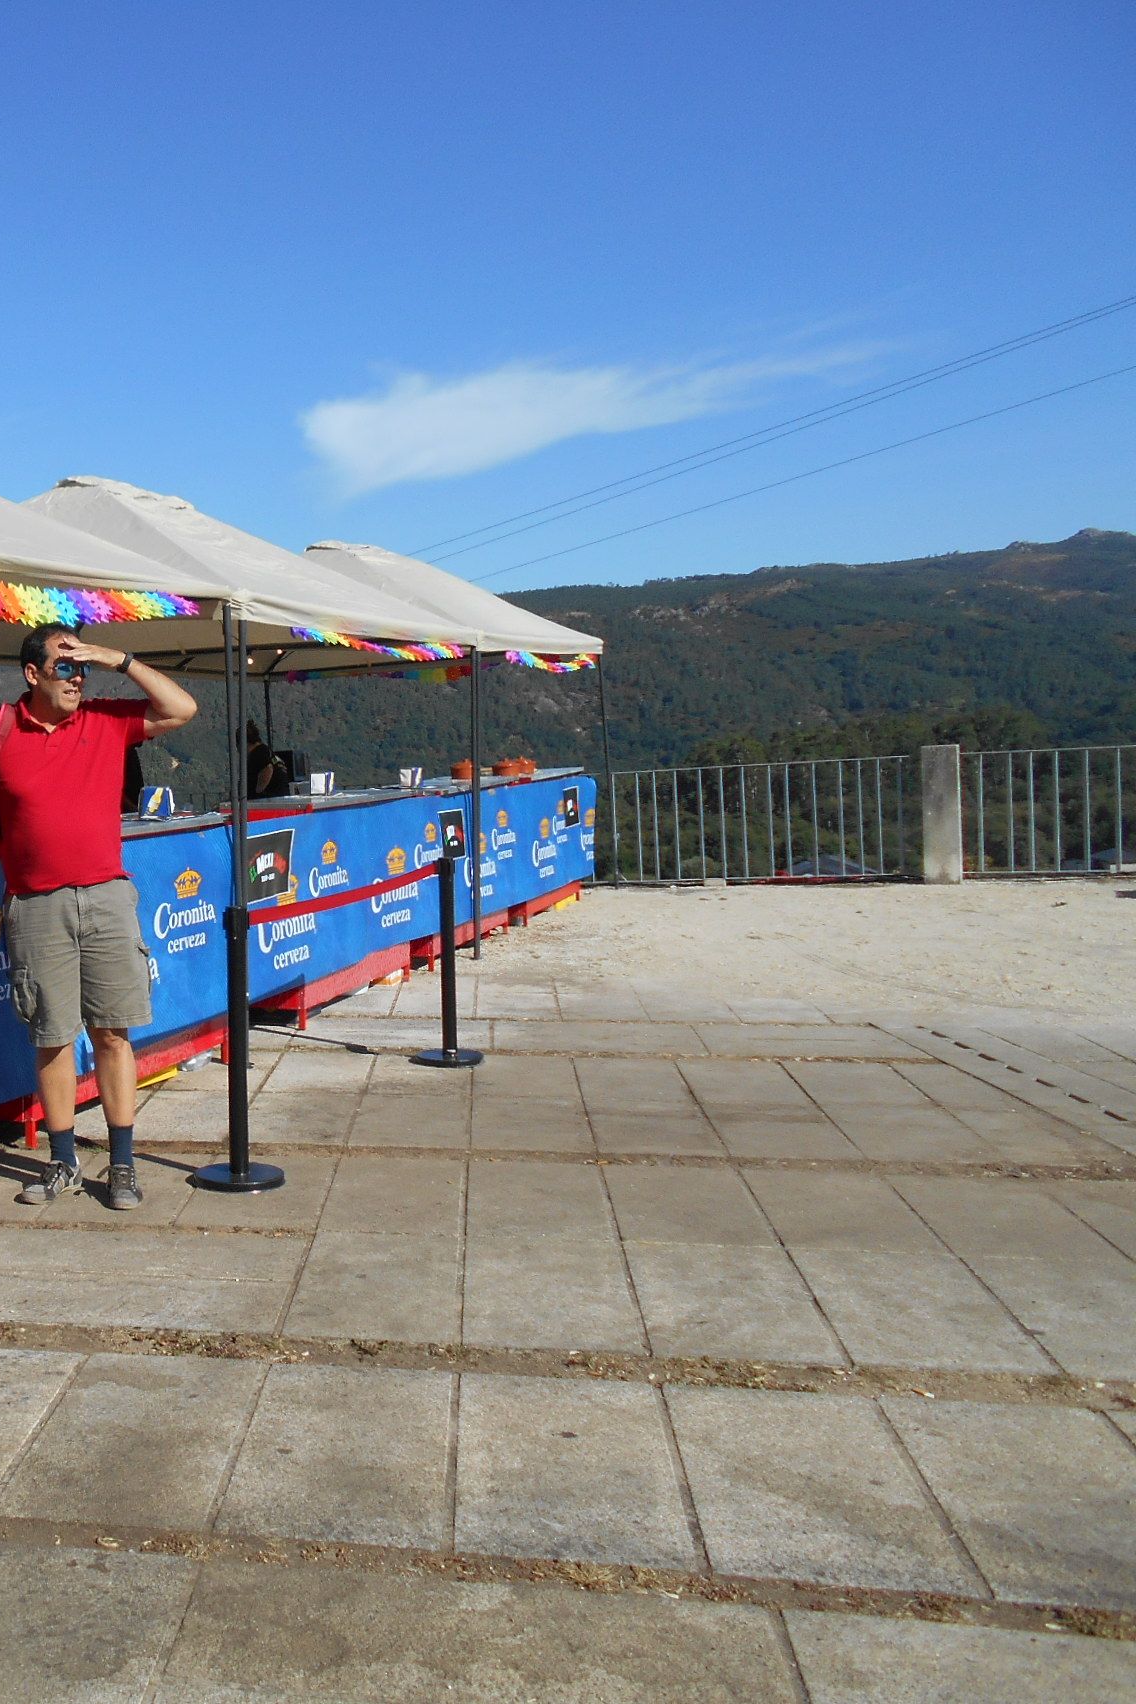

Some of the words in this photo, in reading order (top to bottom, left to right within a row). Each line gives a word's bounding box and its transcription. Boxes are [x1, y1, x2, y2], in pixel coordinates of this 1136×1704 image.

[308, 865, 349, 898] Coronita
[154, 899, 216, 940] Coronita
[381, 908, 411, 928] cerveza
[167, 932, 206, 954] cerveza
[273, 945, 310, 970] cerveza
